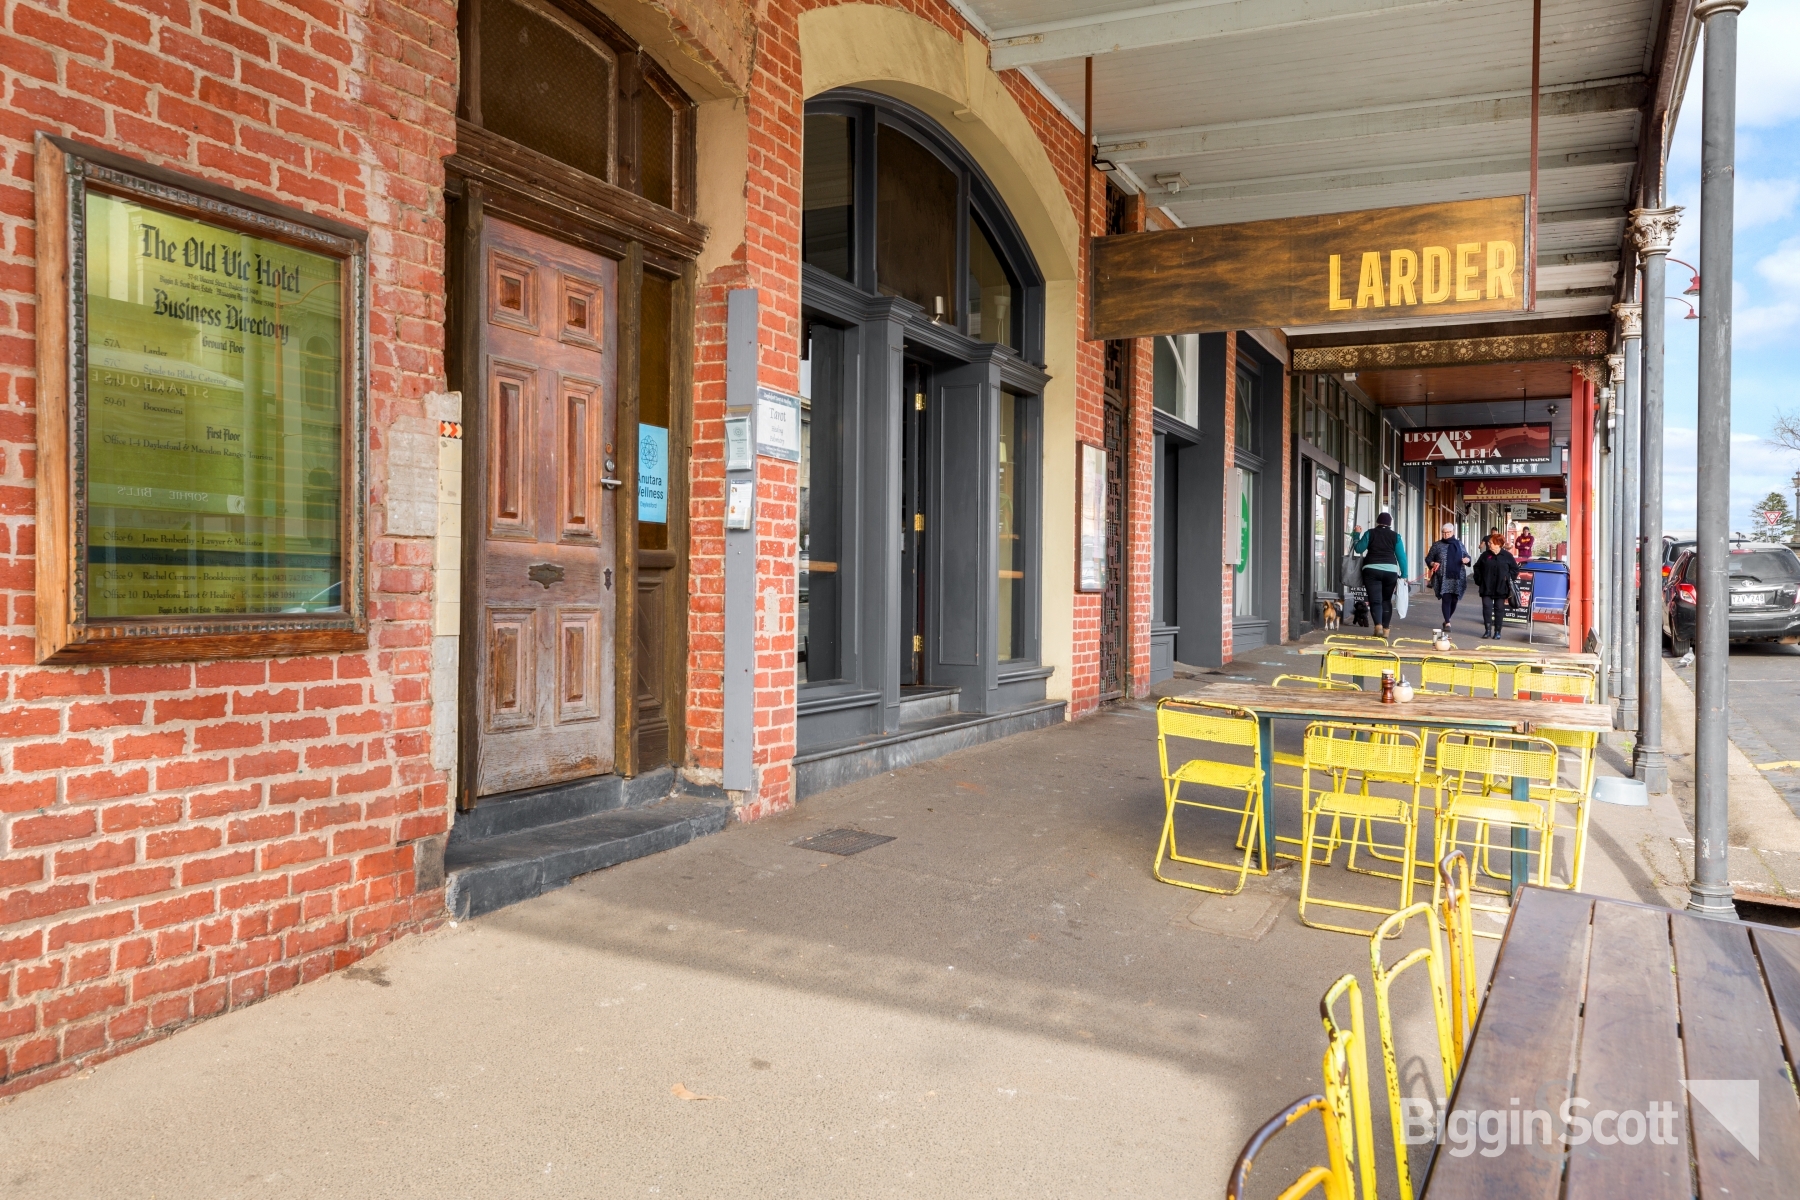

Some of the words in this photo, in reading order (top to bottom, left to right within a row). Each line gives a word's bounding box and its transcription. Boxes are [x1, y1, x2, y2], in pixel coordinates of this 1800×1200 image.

[139, 223, 178, 264] The
[182, 236, 217, 273] Old
[220, 244, 251, 281] Vic
[254, 253, 301, 294] Hotel
[1329, 239, 1517, 311] LARDER
[153, 287, 222, 327] Business
[225, 303, 290, 346] Directory
[103, 338, 121, 349] 57A
[143, 345, 168, 357] Larder
[202, 335, 228, 351] Ground
[228, 340, 246, 354] Floor
[103, 357, 121, 368] 57C
[143, 364, 166, 377] Spade
[177, 369, 197, 380] Blade
[198, 373, 228, 388] Catering
[103, 396, 126, 407] 59-61
[143, 402, 183, 415] Bocconcini
[768, 407, 786, 422] Tarot
[206, 426, 222, 441] First
[223, 428, 241, 442] Floor
[103, 434, 127, 446] Office
[128, 437, 141, 447] 1-4
[143, 439, 181, 453] Daylesford
[182, 443, 190, 452] &
[191, 444, 222, 456] Macedon
[223, 448, 247, 459] Ranges
[247, 450, 273, 461] Tourism
[1453, 463, 1539, 476] BAKERY
[1490, 486, 1528, 495] himalaya
[103, 532, 127, 542] Office
[142, 534, 158, 543] Jane
[160, 534, 195, 545] Penberthy
[201, 537, 225, 547] Lawyer
[234, 538, 263, 546] Mediator
[103, 570, 127, 580] Office
[127, 572, 133, 580] 9
[142, 571, 167, 581] Rachel
[168, 571, 196, 581] Curnow
[203, 572, 246, 583] Bookkeeping
[103, 589, 127, 599] Office
[128, 590, 138, 599] 10
[142, 590, 181, 601] Daylesford
[183, 590, 201, 599] Tarot
[201, 590, 208, 598] &
[209, 591, 236, 600] Healing
